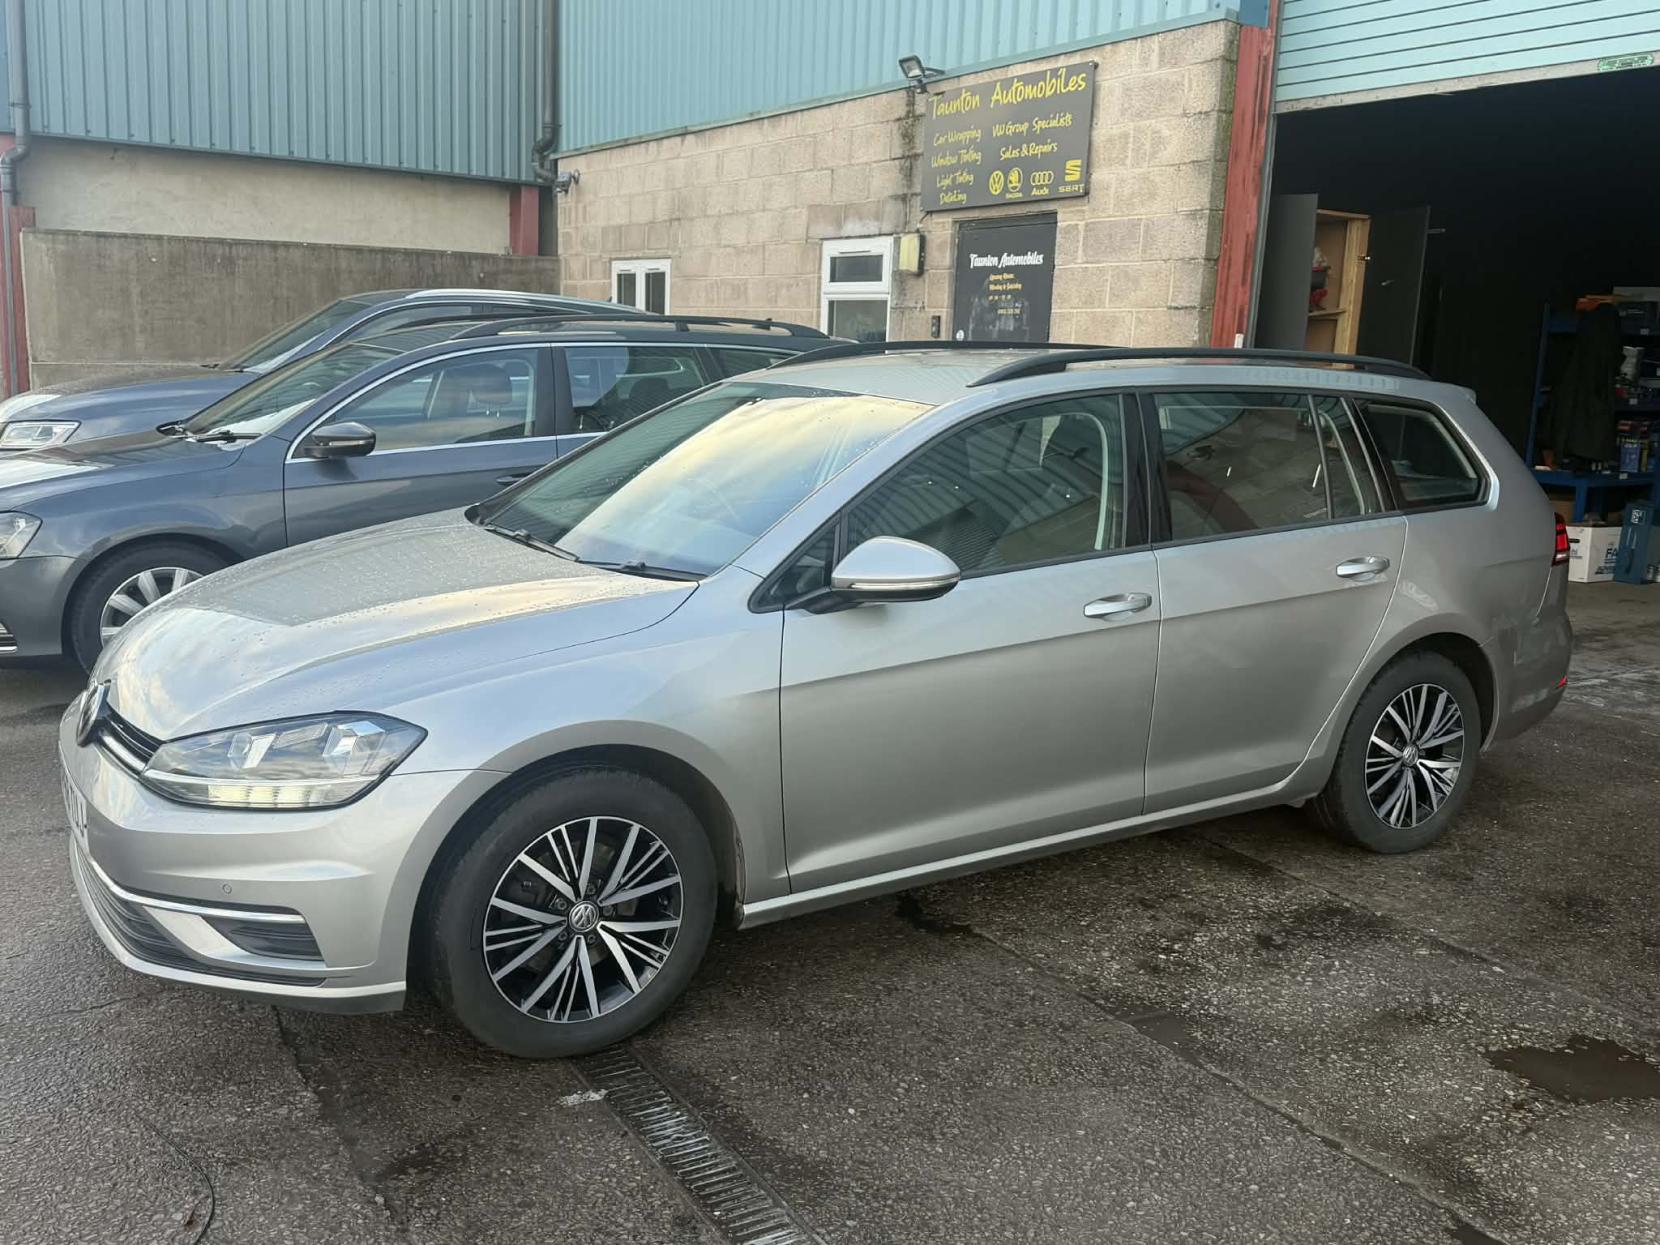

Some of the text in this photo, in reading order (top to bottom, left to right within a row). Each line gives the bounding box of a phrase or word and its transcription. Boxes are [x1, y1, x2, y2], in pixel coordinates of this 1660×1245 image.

[928, 68, 1086, 119] Taunton Automobiles
[948, 125, 981, 144] Wrapping
[992, 113, 1072, 137] VW Group Specialists
[1000, 138, 1058, 161] Sales & Repairs
[1031, 187, 1049, 195] Audi
[969, 251, 1043, 268] Taunton Automobiles
